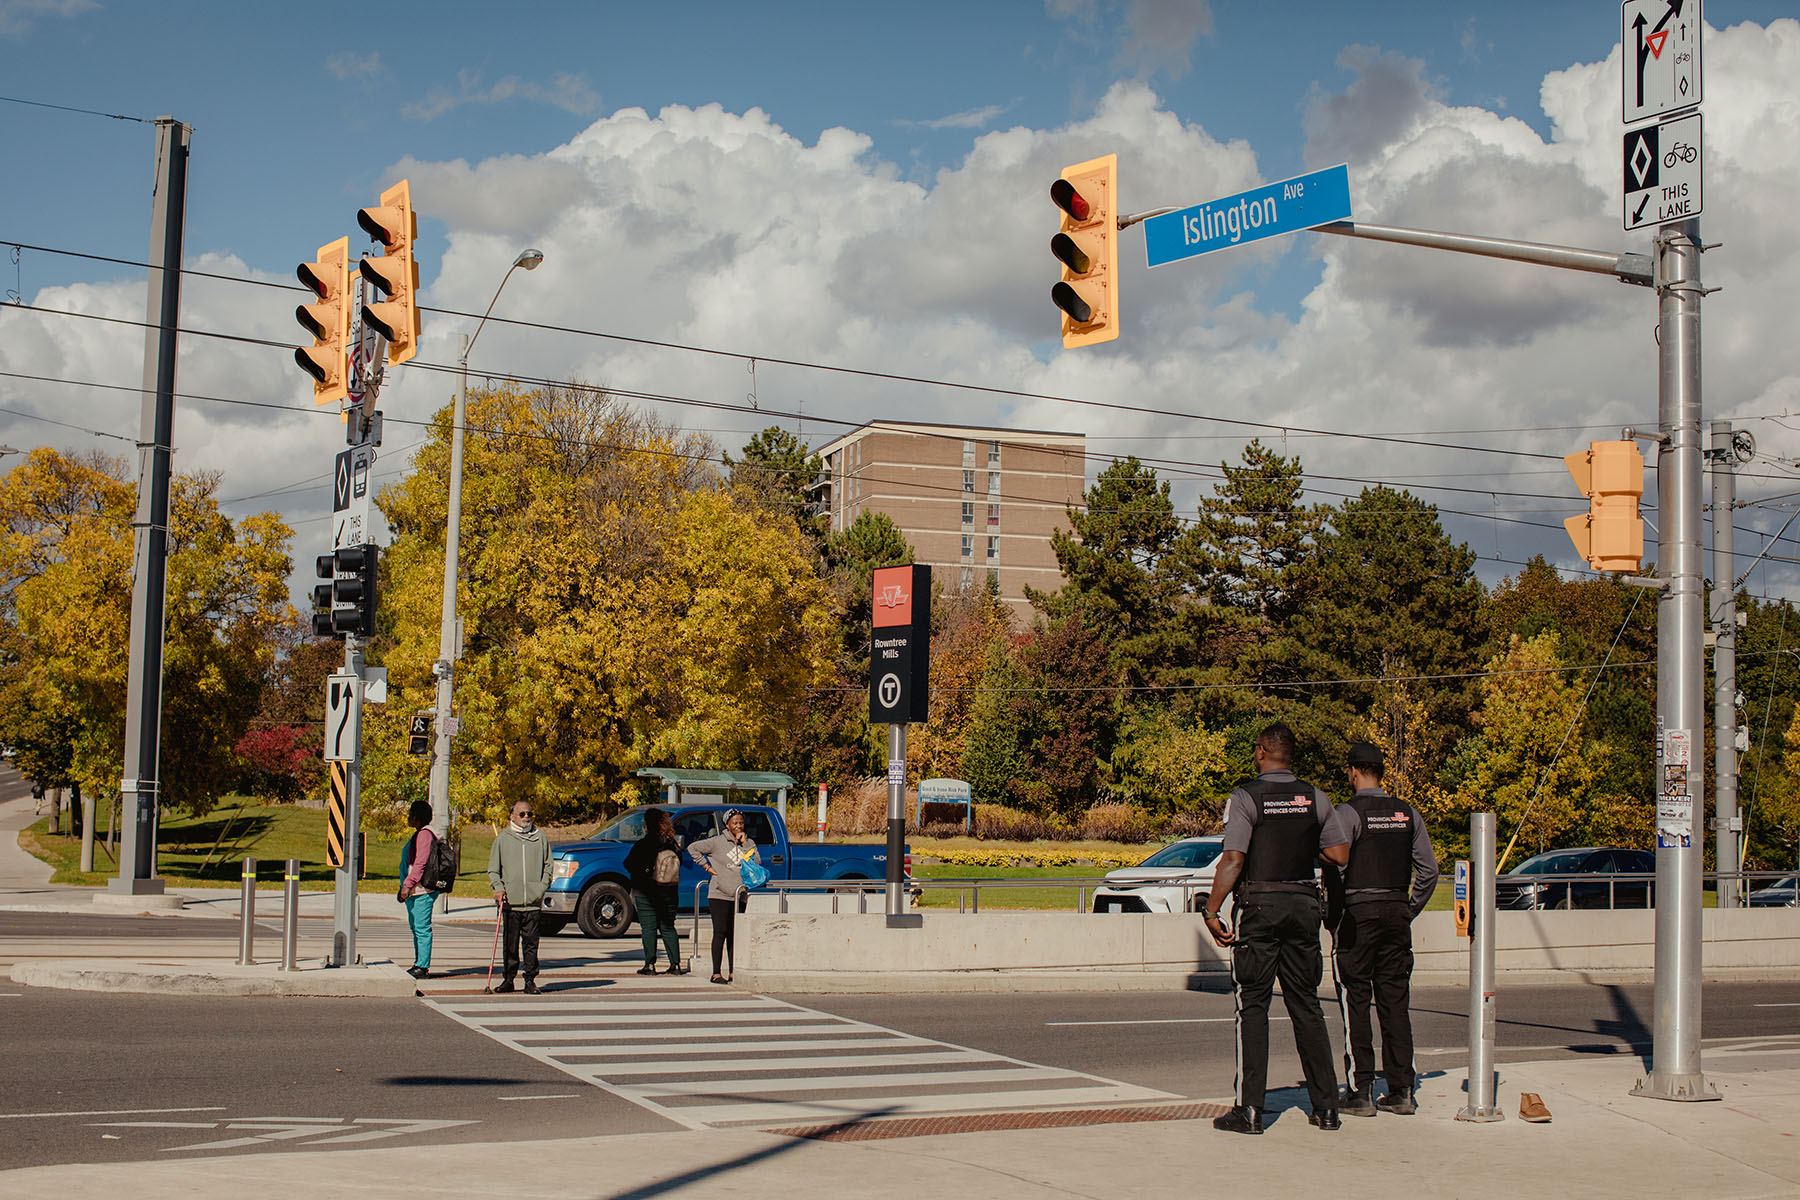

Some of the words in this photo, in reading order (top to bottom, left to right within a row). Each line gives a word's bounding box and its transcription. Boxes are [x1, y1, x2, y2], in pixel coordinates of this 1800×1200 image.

[1661, 182, 1689, 201] THIS
[1183, 196, 1278, 243] Islington
[1283, 182, 1304, 201] Ave
[1659, 199, 1691, 220] LANE
[350, 514, 362, 529] THIS
[347, 530, 362, 546] LANE
[874, 638, 907, 648] Rowntree
[882, 648, 899, 659] Mills
[1263, 800, 1292, 808] PROVINCIAL
[1263, 807, 1288, 815] OFFENCES
[1288, 806, 1308, 814] OFFICER
